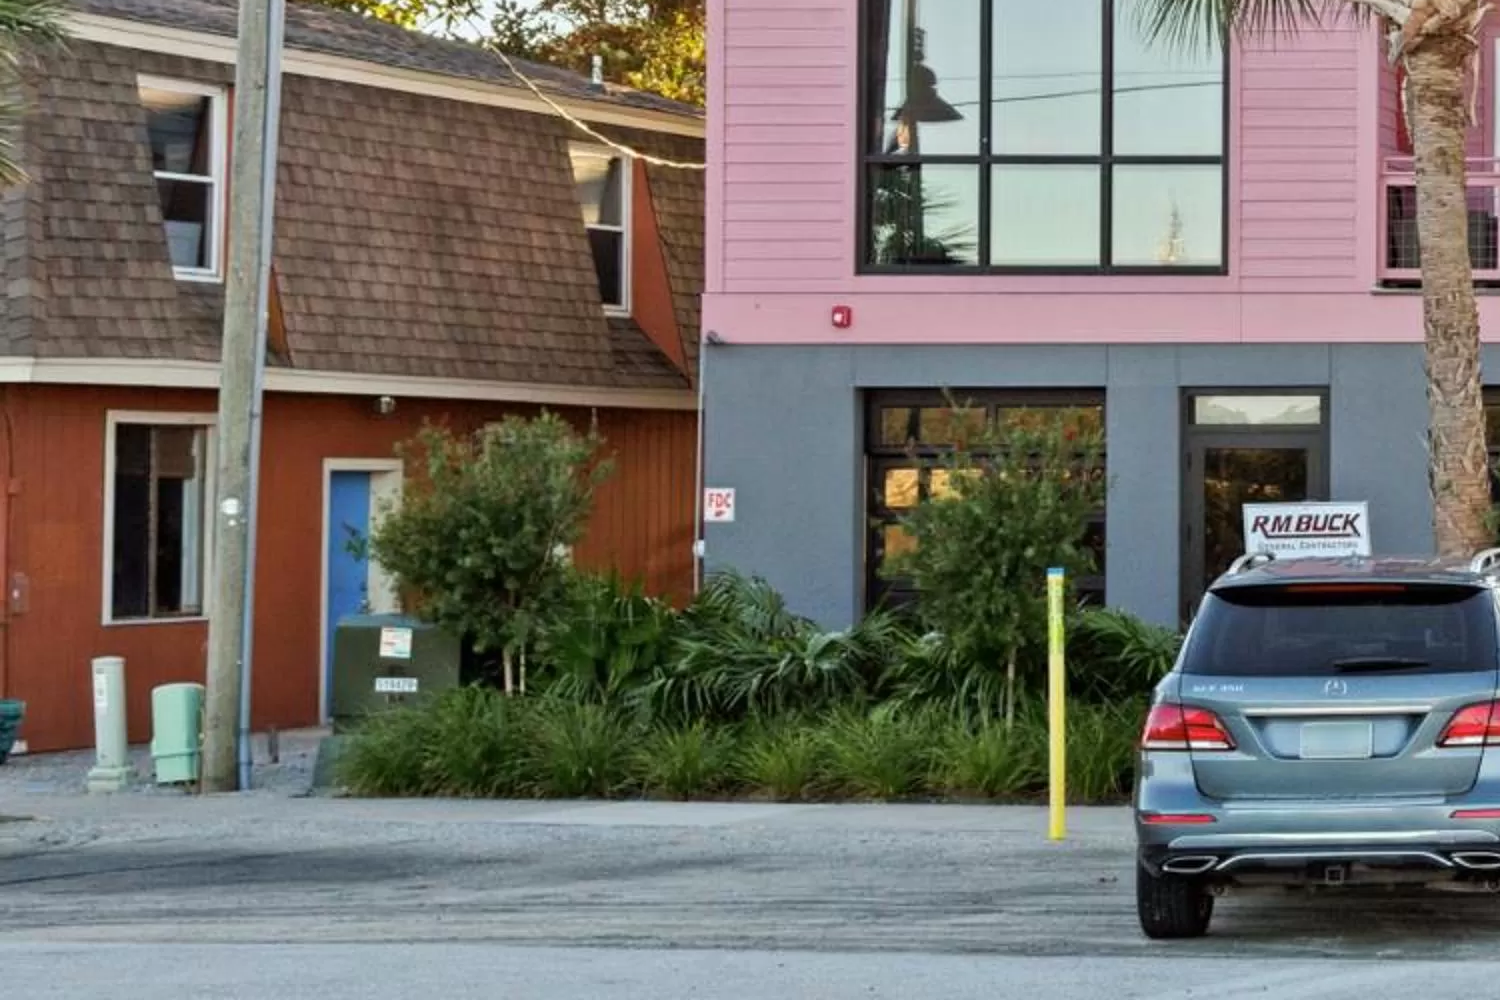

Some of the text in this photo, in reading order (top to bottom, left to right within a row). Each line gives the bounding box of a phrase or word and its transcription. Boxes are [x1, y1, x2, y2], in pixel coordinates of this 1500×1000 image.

[708, 493, 731, 508] FDC
[1252, 513, 1361, 537] RM BUCK
